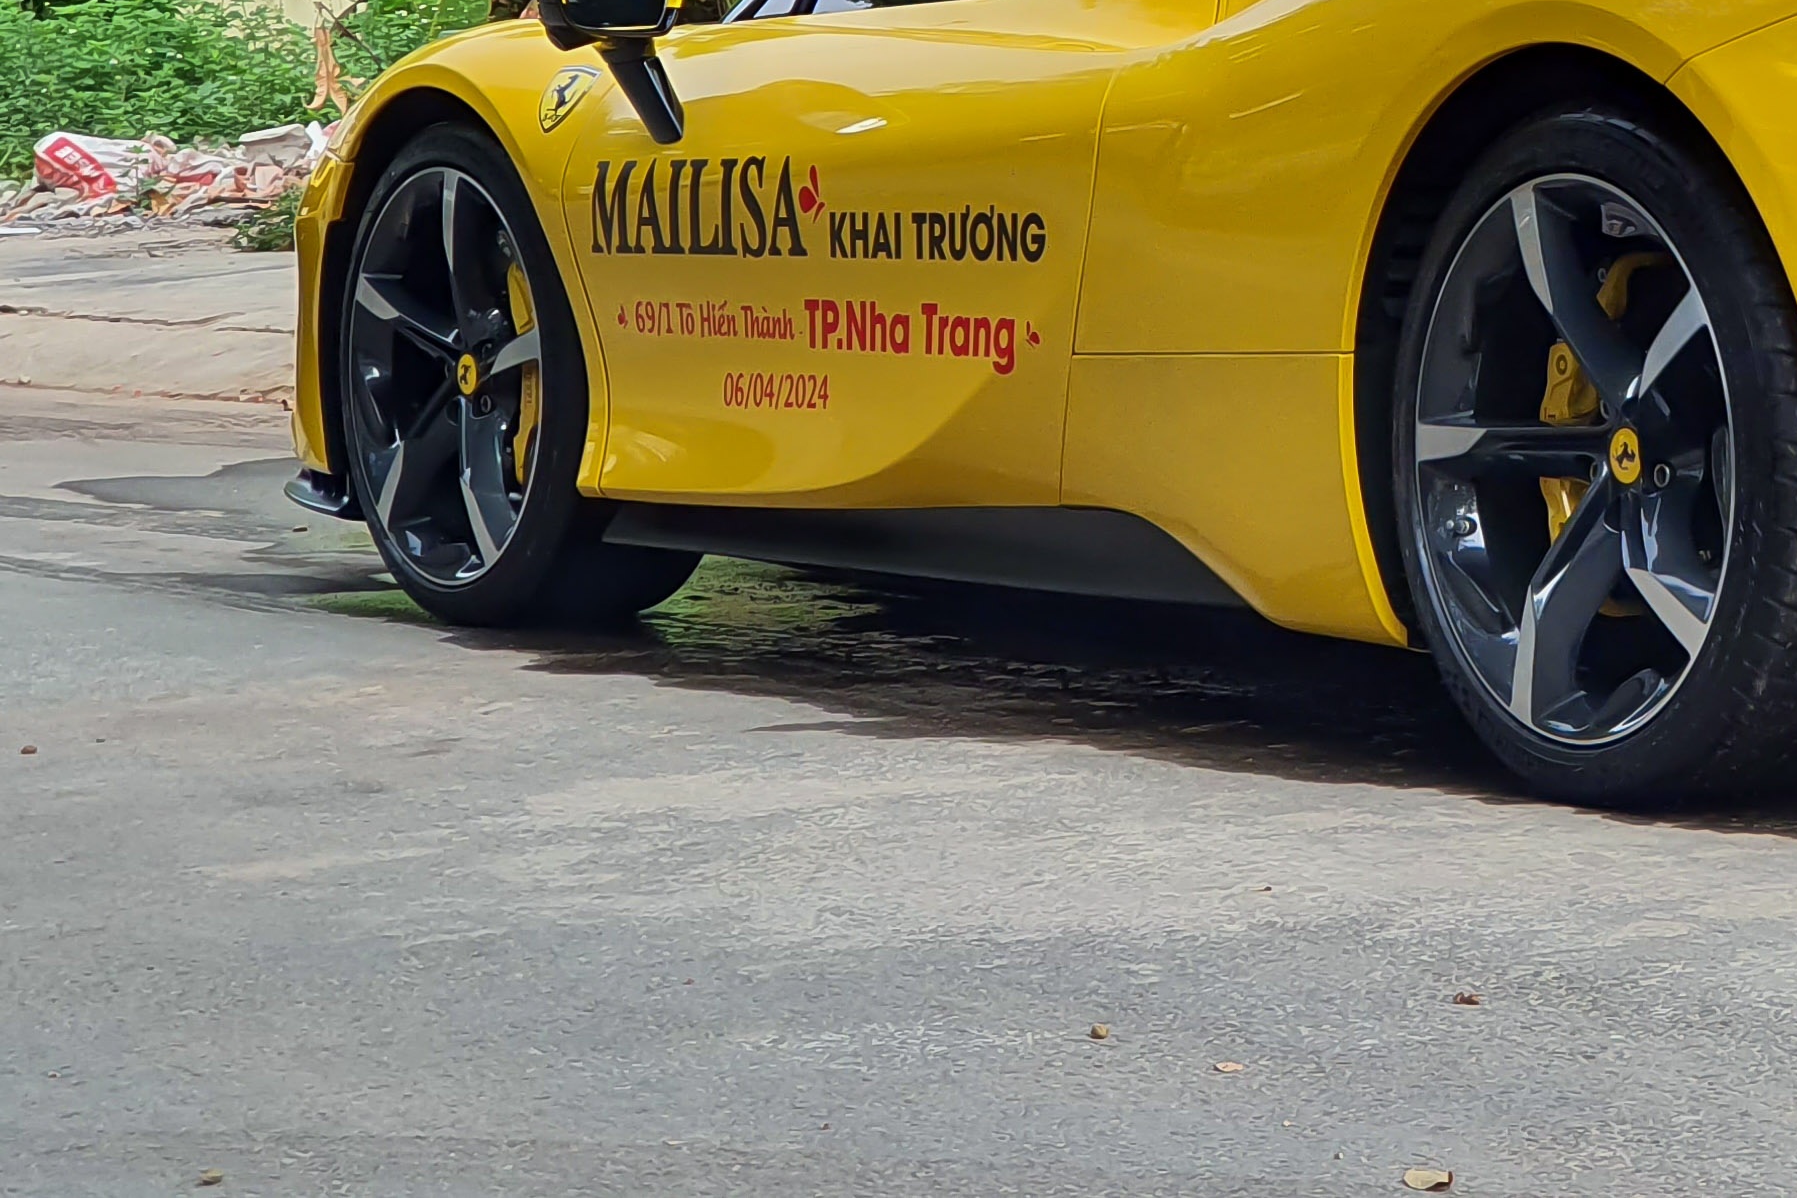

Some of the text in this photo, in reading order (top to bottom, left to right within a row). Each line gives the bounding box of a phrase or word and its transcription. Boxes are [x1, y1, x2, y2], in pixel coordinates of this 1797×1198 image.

[591, 155, 808, 258] MAILISA
[829, 204, 1046, 262] KHAI TRƯƠNG
[634, 299, 1015, 375] 69/1 Tô Hiến Thành TP.Nha Trang
[723, 372, 829, 409] 06/04/2024
